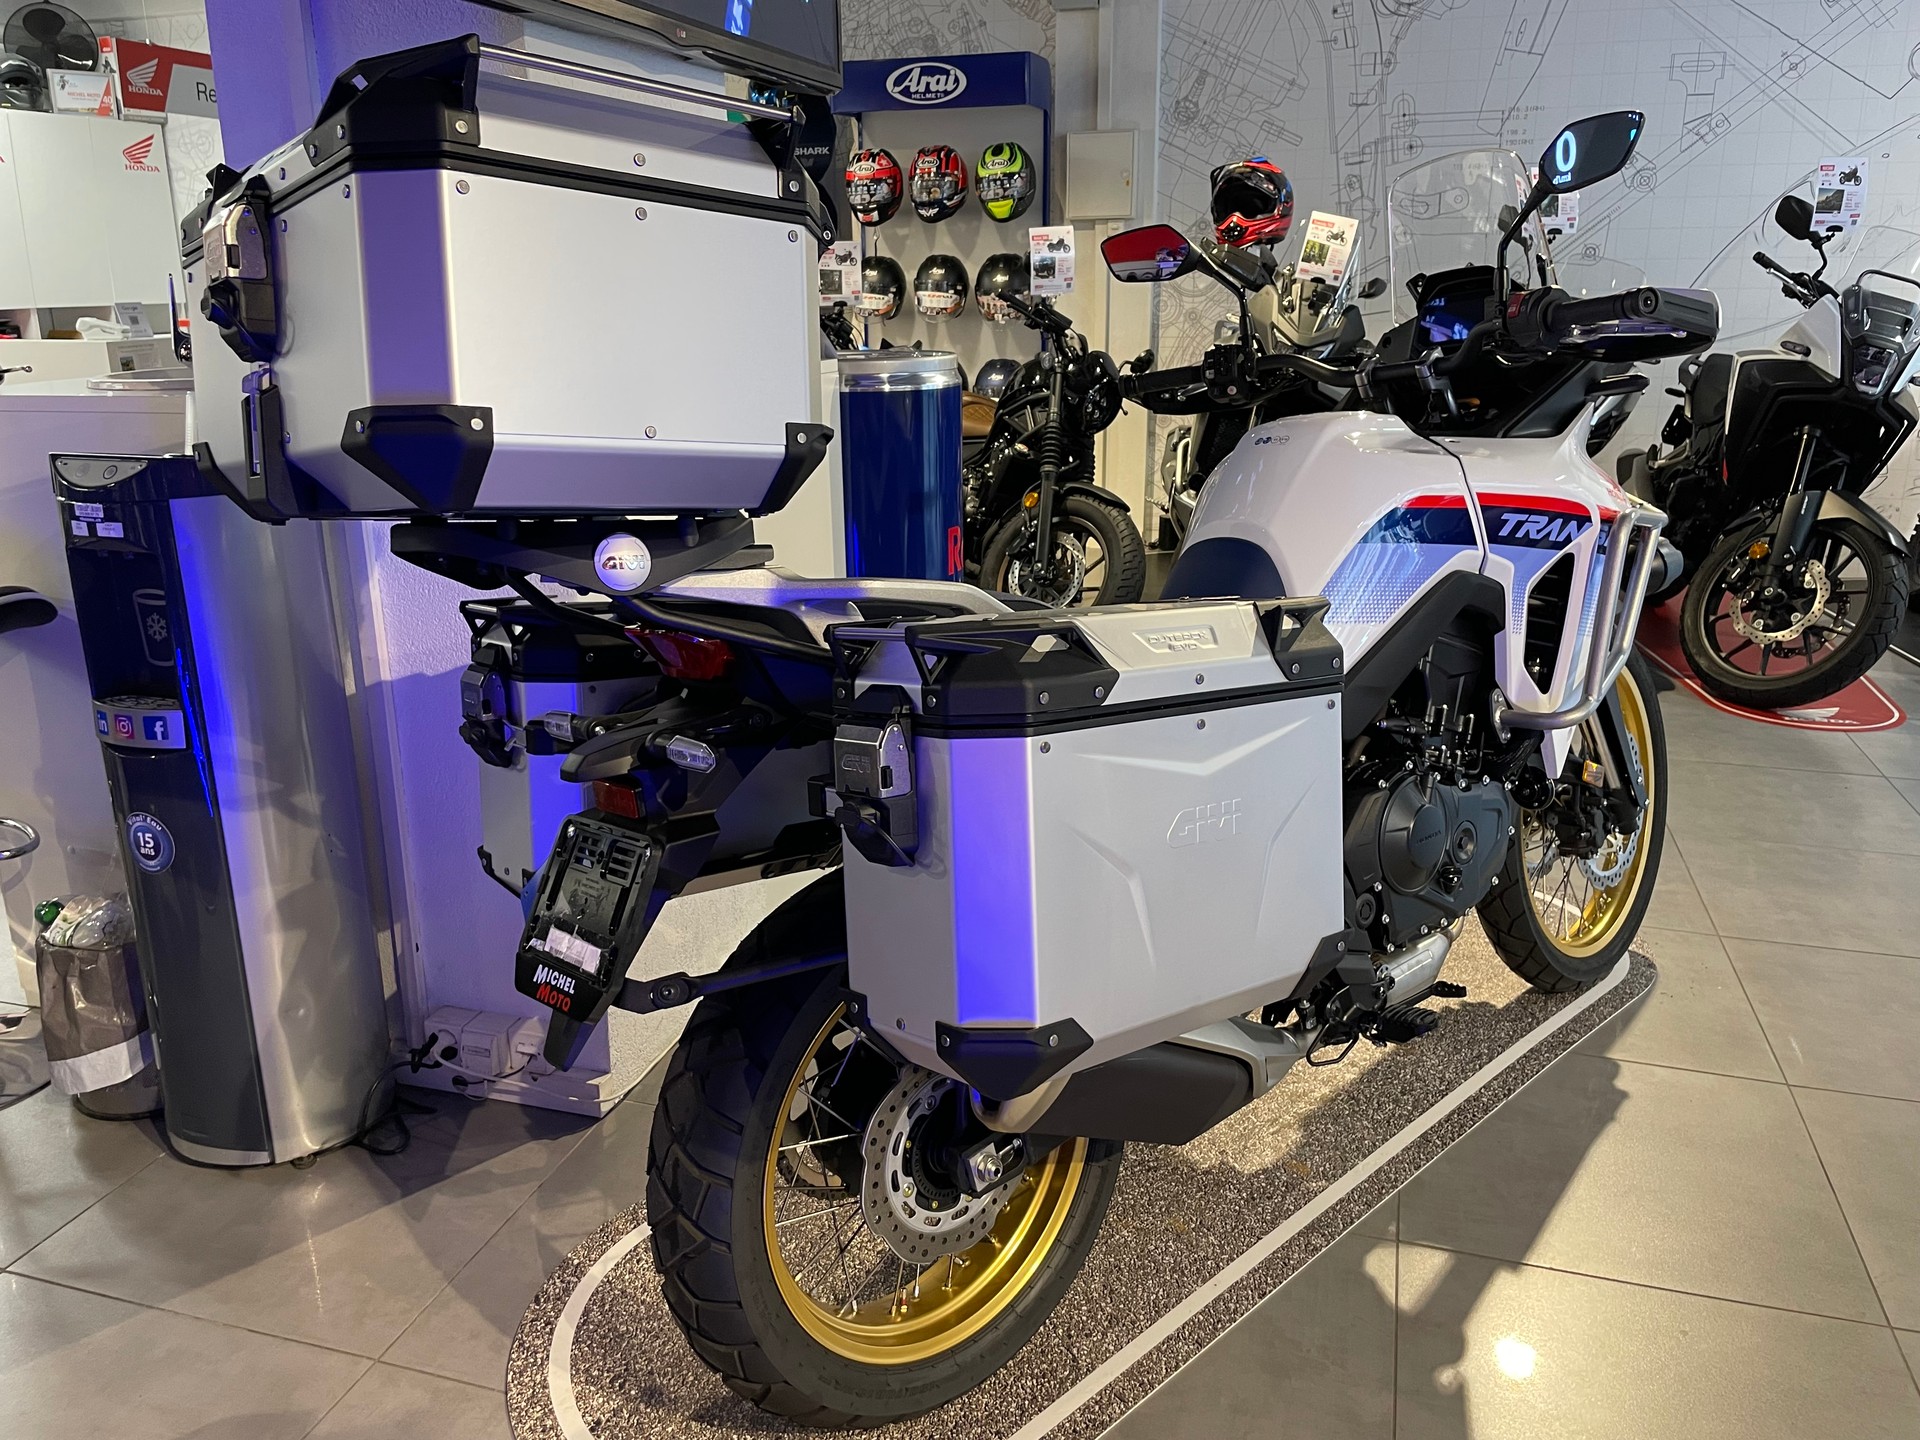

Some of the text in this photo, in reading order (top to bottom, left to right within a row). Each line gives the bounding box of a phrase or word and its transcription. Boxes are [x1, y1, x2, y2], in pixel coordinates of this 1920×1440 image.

[892, 67, 958, 94] Arai
[128, 85, 163, 97] HONDA
[794, 146, 830, 156] SHARK
[919, 158, 938, 167] Arai
[987, 160, 1008, 169] Arai
[125, 163, 160, 173] HONDA
[854, 165, 874, 174] Arai
[137, 832, 154, 848] 15
[140, 846, 155, 856] ans
[533, 964, 576, 995] MICHEL
[536, 982, 571, 1013] MOTO
